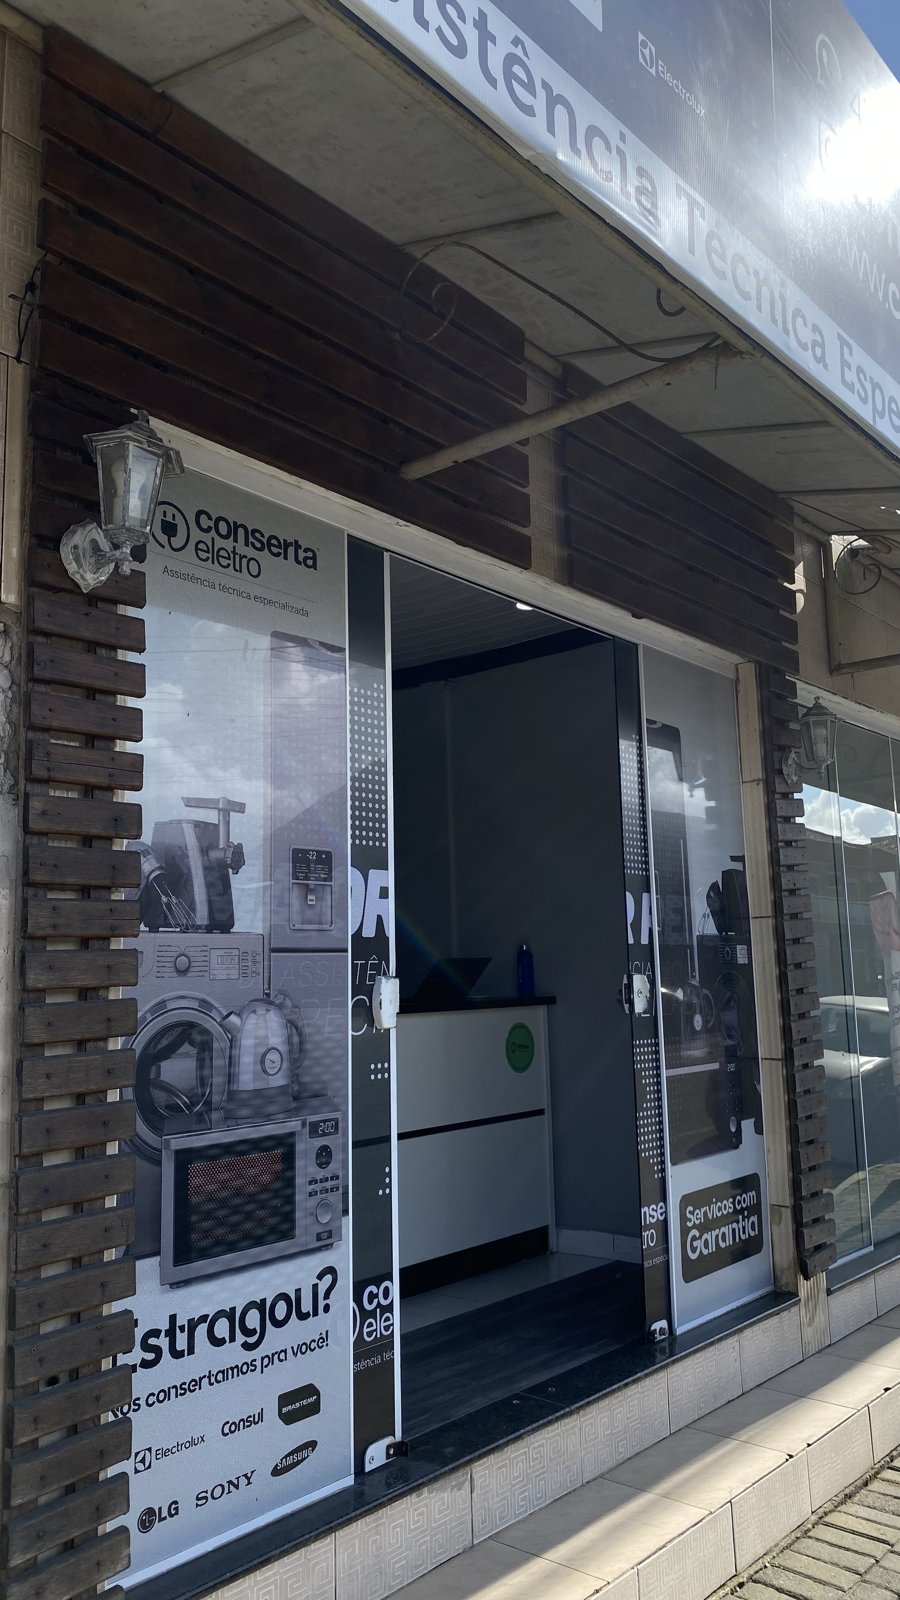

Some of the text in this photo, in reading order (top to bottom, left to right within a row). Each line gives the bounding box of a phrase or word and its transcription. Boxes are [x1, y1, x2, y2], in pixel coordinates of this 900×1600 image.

[658, 60, 706, 118] Electrolux
[676, 182, 828, 371] Técnica
[195, 509, 318, 570] conserta
[195, 537, 261, 578] eletro
[162, 565, 309, 617] Assistência técnica especializada
[735, 1190, 756, 1210] com
[686, 1210, 758, 1260] Garantia
[363, 1281, 393, 1311] co
[363, 1308, 393, 1342] ele
[145, 1358, 258, 1408] consertamos
[260, 1346, 287, 1374] pra
[291, 1330, 329, 1358] você!
[221, 1408, 264, 1437] Consul
[281, 1395, 318, 1414] BRASTEMP
[155, 1434, 205, 1460] Electrolux
[277, 1447, 312, 1470] SAMSUNG
[195, 1470, 256, 1508] SONY
